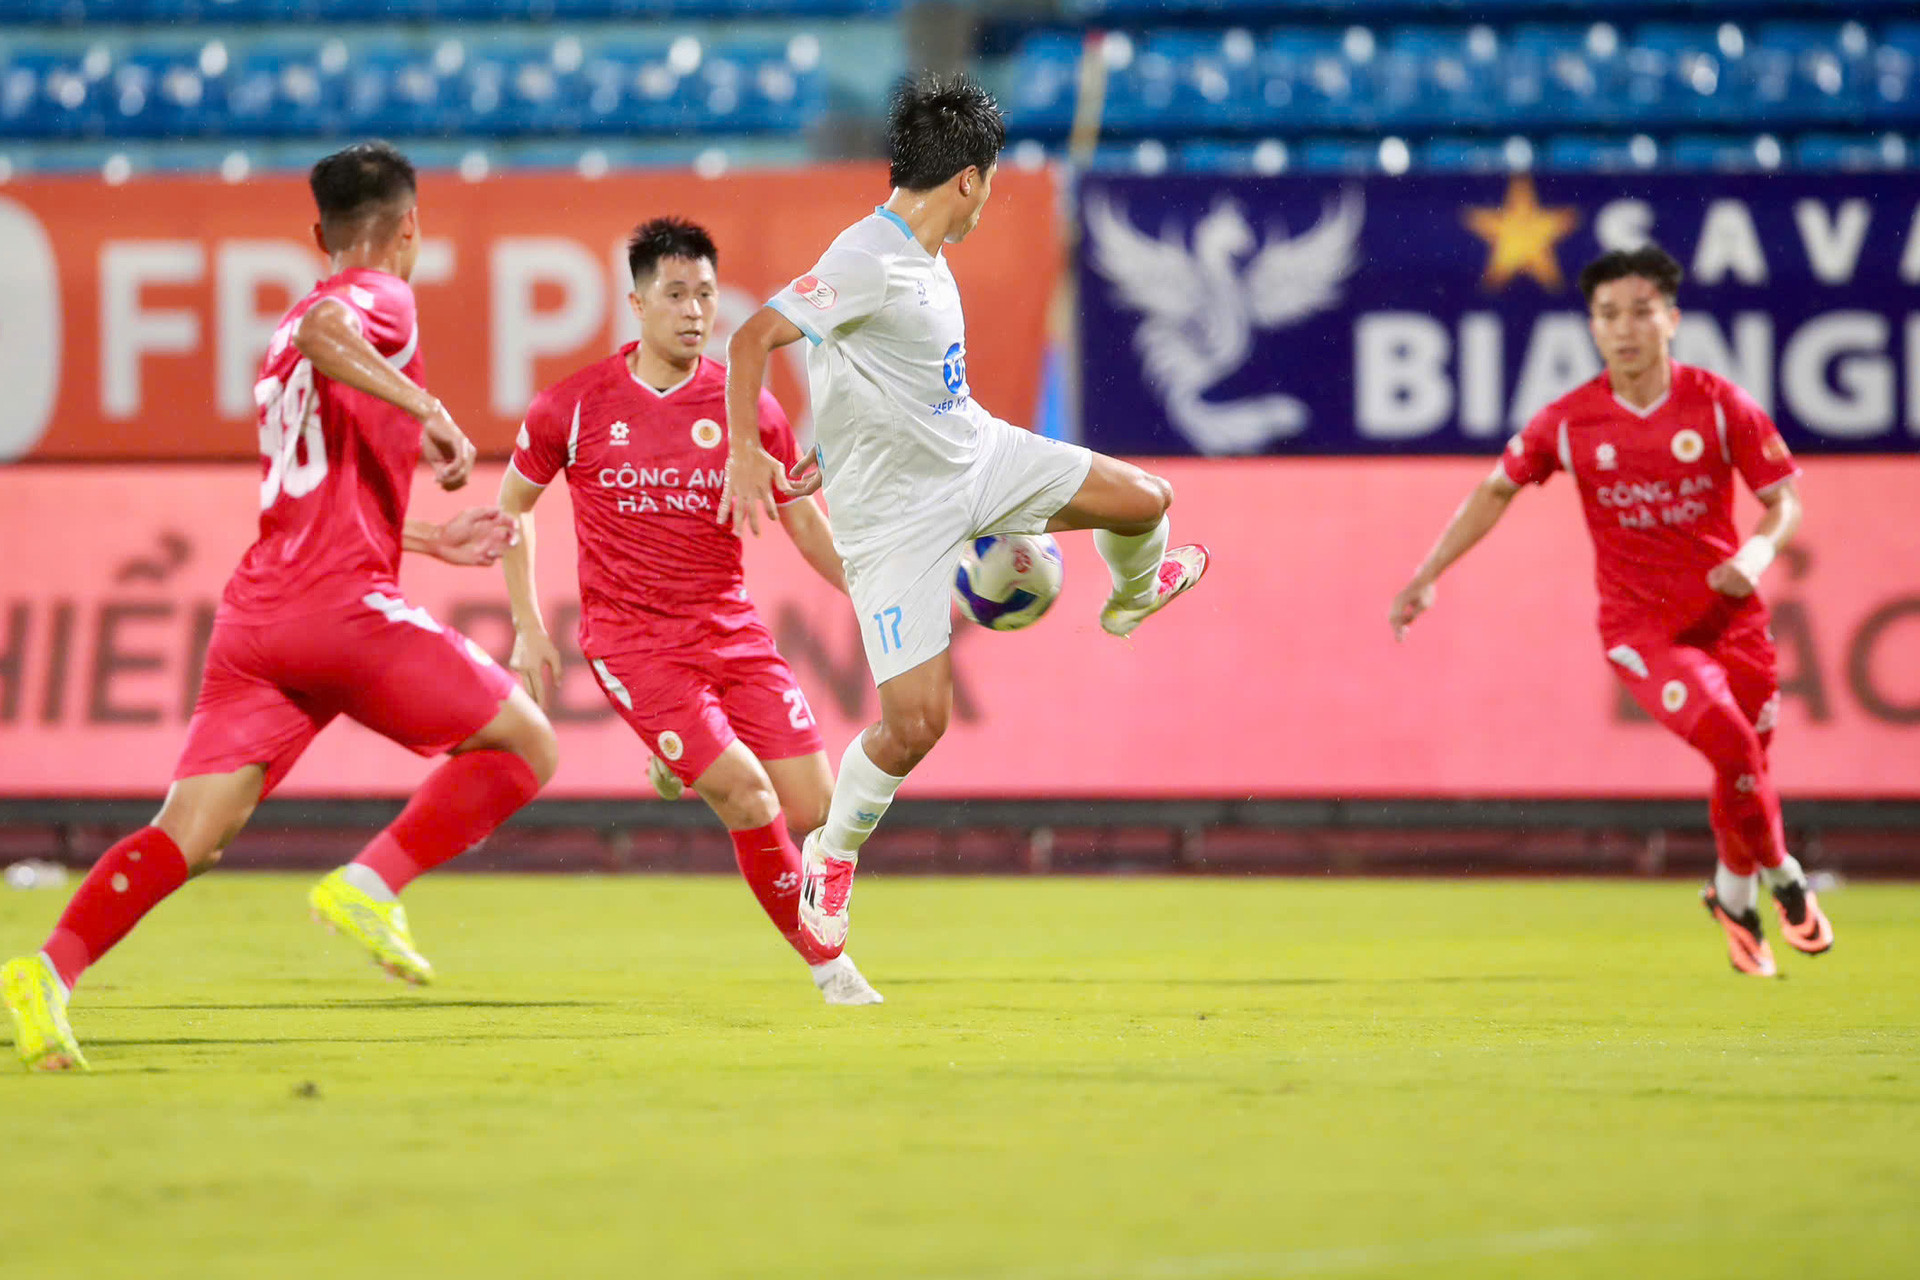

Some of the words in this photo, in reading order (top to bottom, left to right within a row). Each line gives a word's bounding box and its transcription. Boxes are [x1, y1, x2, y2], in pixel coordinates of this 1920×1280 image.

[1594, 198, 1920, 286] SAV
[599, 462, 680, 489] CÔNG
[687, 468, 726, 489] AN
[617, 490, 660, 514] HÀ
[873, 605, 902, 654] 17
